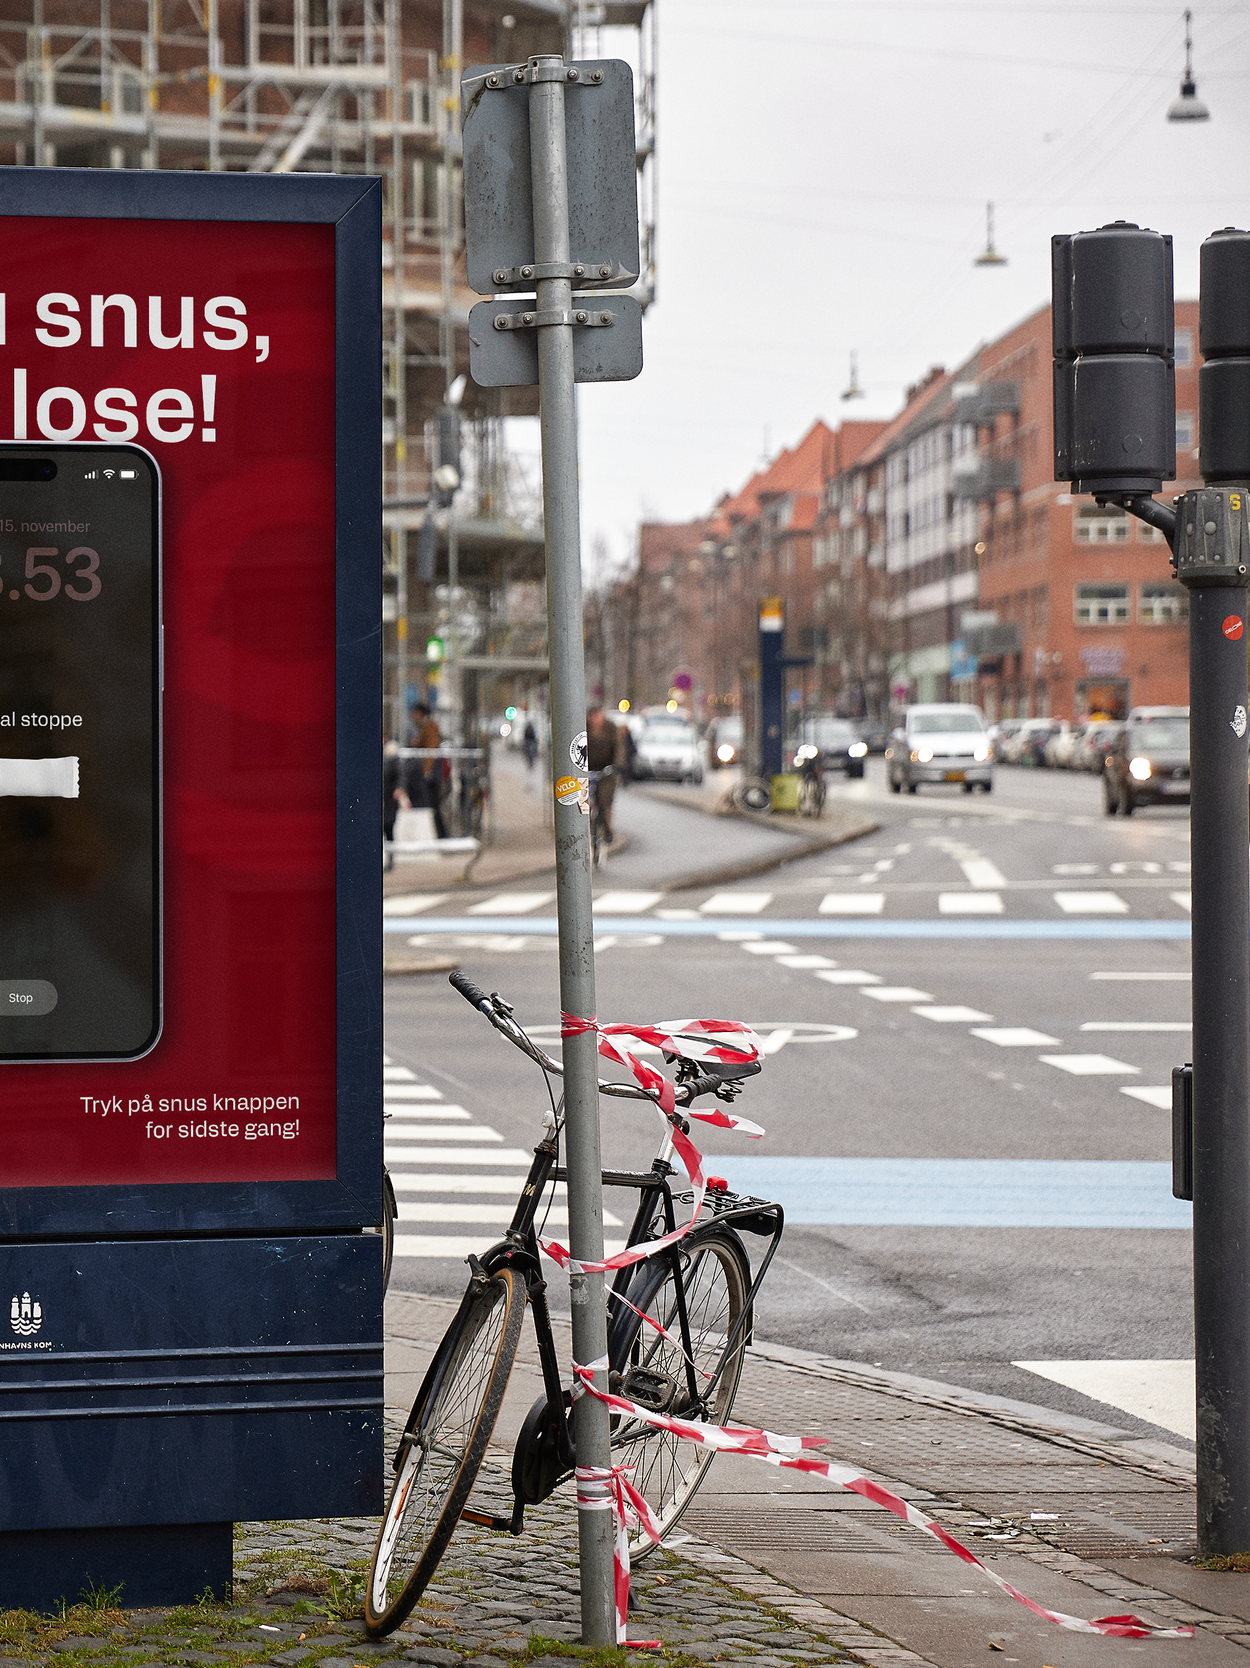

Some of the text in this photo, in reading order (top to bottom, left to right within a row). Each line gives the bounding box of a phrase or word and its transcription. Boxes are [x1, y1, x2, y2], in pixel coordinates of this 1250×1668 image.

[34, 291, 270, 363] snus,
[13, 368, 217, 443] lose!
[21, 519, 91, 533] november
[20, 711, 83, 731] stoppe
[556, 780, 576, 793] VELO
[8, 992, 34, 1005] Stop
[79, 1093, 300, 1117] Tryk på snus knappen
[145, 1119, 301, 1141] for sidste gang!
